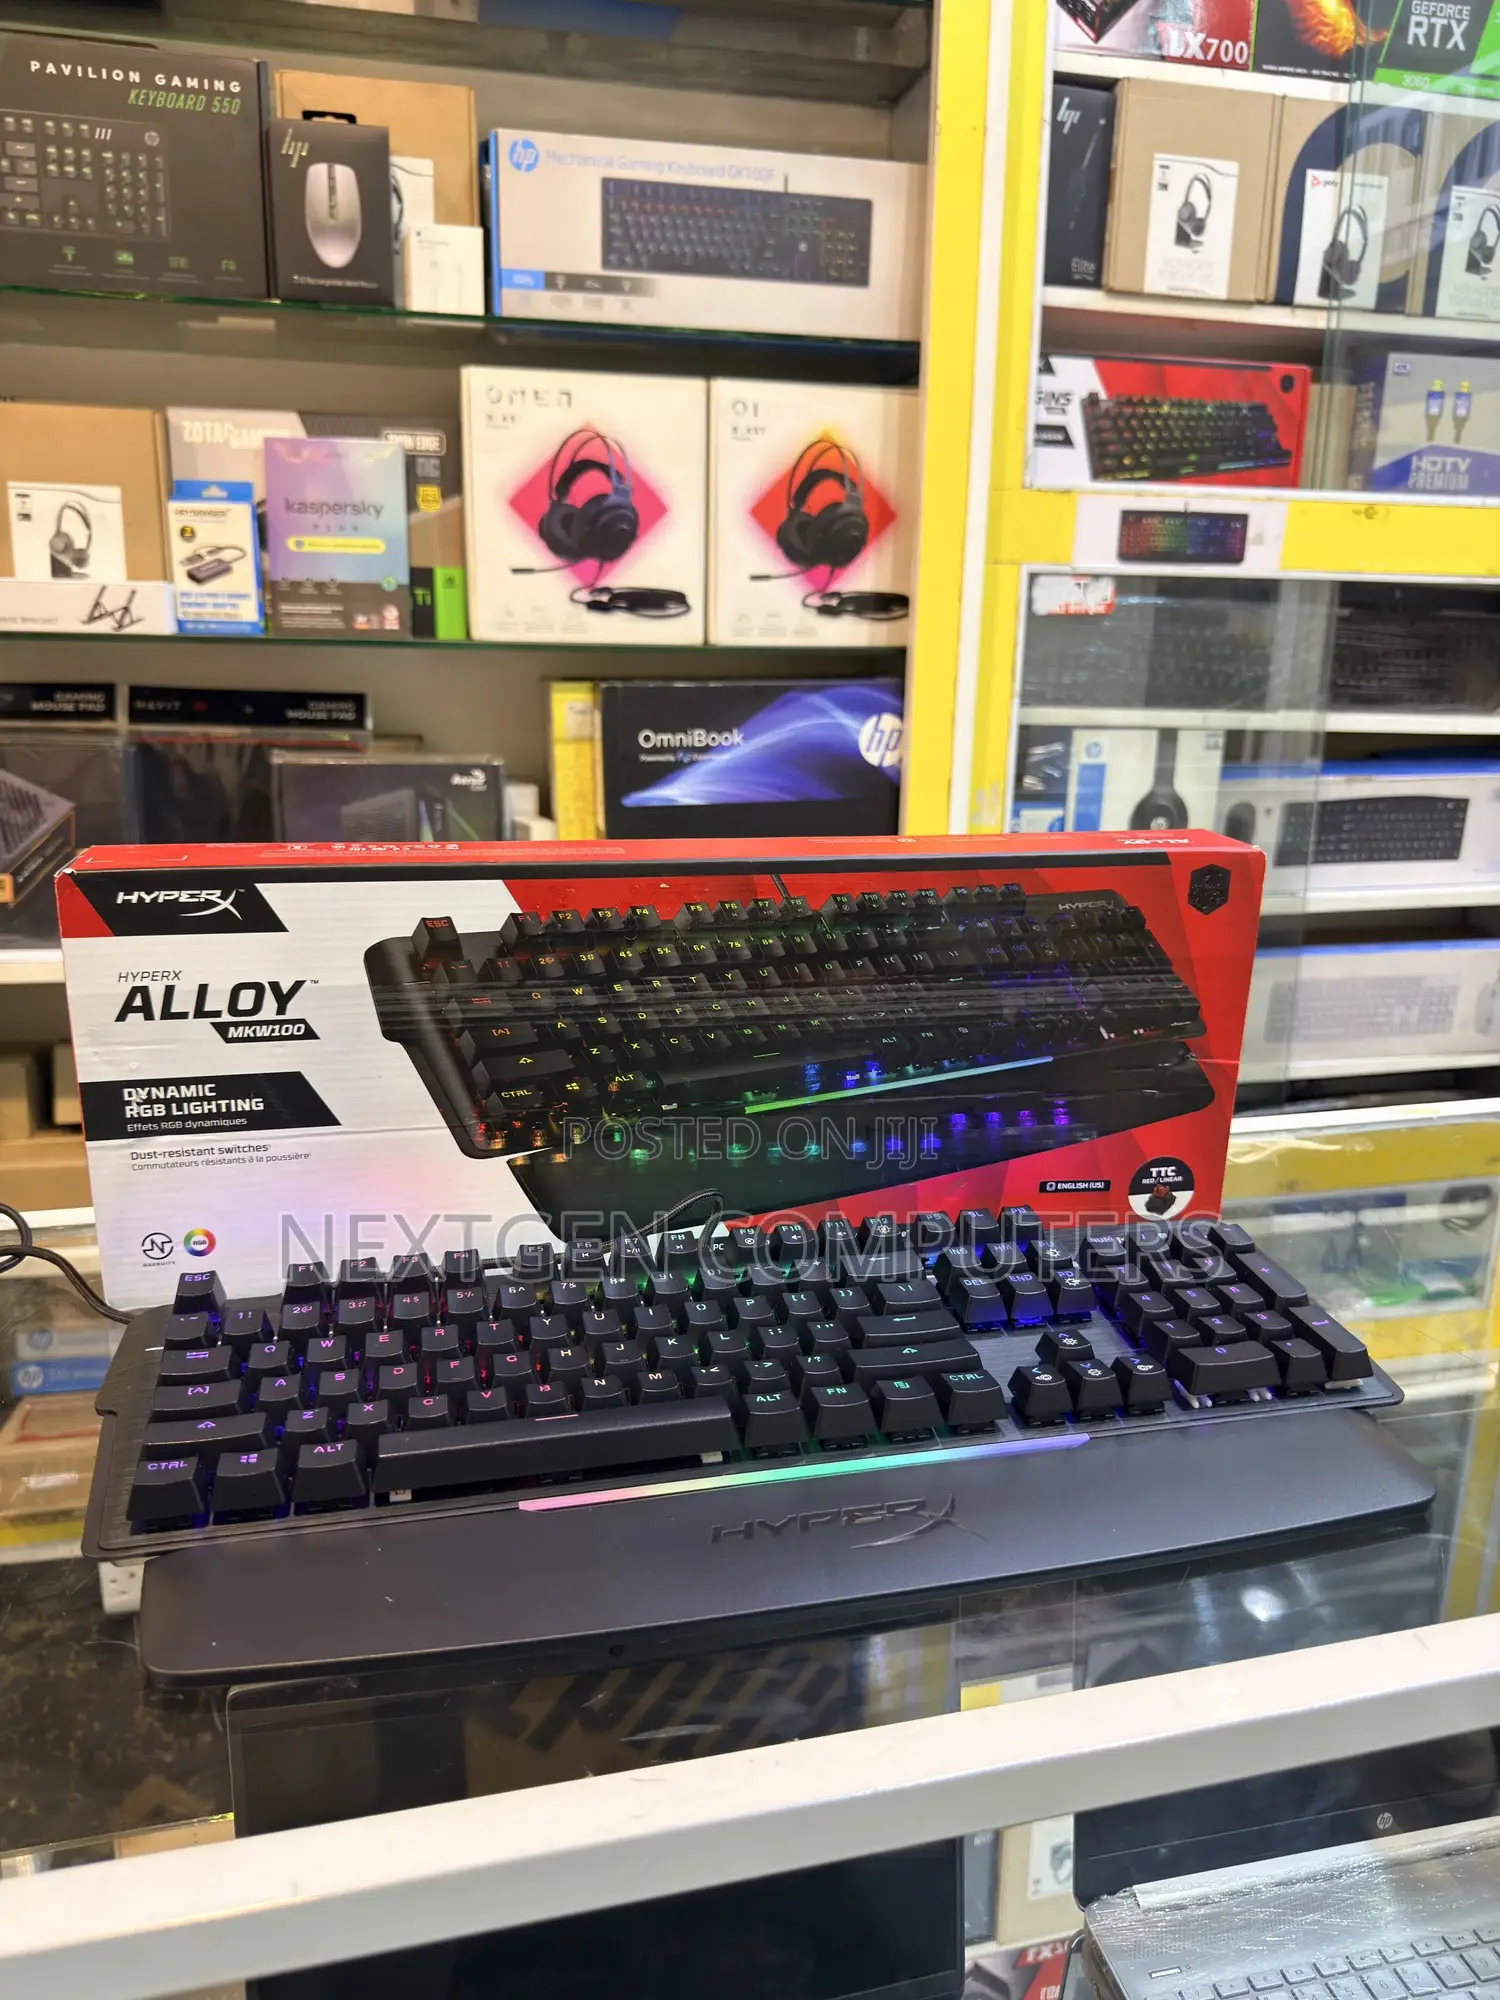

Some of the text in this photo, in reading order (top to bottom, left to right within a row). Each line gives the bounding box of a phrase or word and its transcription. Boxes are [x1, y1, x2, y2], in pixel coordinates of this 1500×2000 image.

[1411, 0, 1471, 20] GEFORCE
[1407, 14, 1468, 51] RTX
[30, 60, 242, 93] PAVILION GAMING
[128, 89, 206, 112] KEYBOARD
[509, 140, 540, 171] hp
[546, 151, 616, 169] Mechanical
[618, 155, 664, 175] Gaming
[667, 161, 724, 178] Keyboard
[285, 498, 384, 520] kaspersky
[638, 728, 744, 749] OmniBook
[116, 889, 243, 921] HYPERX
[426, 919, 449, 928] ESC
[118, 970, 182, 983] HYPERX
[114, 980, 307, 1022] ALLOY
[228, 1023, 305, 1038] MKW100
[123, 1084, 216, 1101] DYNAMIC
[501, 1087, 532, 1099] CTRL
[125, 1098, 264, 1118] RGB LIGHTING
[127, 1117, 248, 1132] Effets RGB dynamiques
[131, 1147, 215, 1161] Dust-resistant
[132, 1160, 199, 1171] Commutateurs
[201, 1156, 247, 1167] résistants
[256, 1155, 264, 1163] la
[1150, 1166, 1177, 1177] TTC
[1057, 1181, 1104, 1190] ENGLISH (US)
[350, 1260, 367, 1268] F2
[185, 1273, 211, 1282] ESC
[1009, 1274, 1033, 1282] END
[434, 1328, 445, 1337] R
[488, 1323, 500, 1331] T
[320, 1340, 334, 1348] W
[378, 1334, 390, 1343] E
[560, 1349, 572, 1357] H
[950, 1373, 984, 1381] CTRL
[827, 1387, 847, 1395] FN
[756, 1393, 781, 1402] ALT
[313, 1443, 345, 1454] ALT
[147, 1460, 188, 1471] CTRL
[711, 1493, 988, 1549] HYPERX
